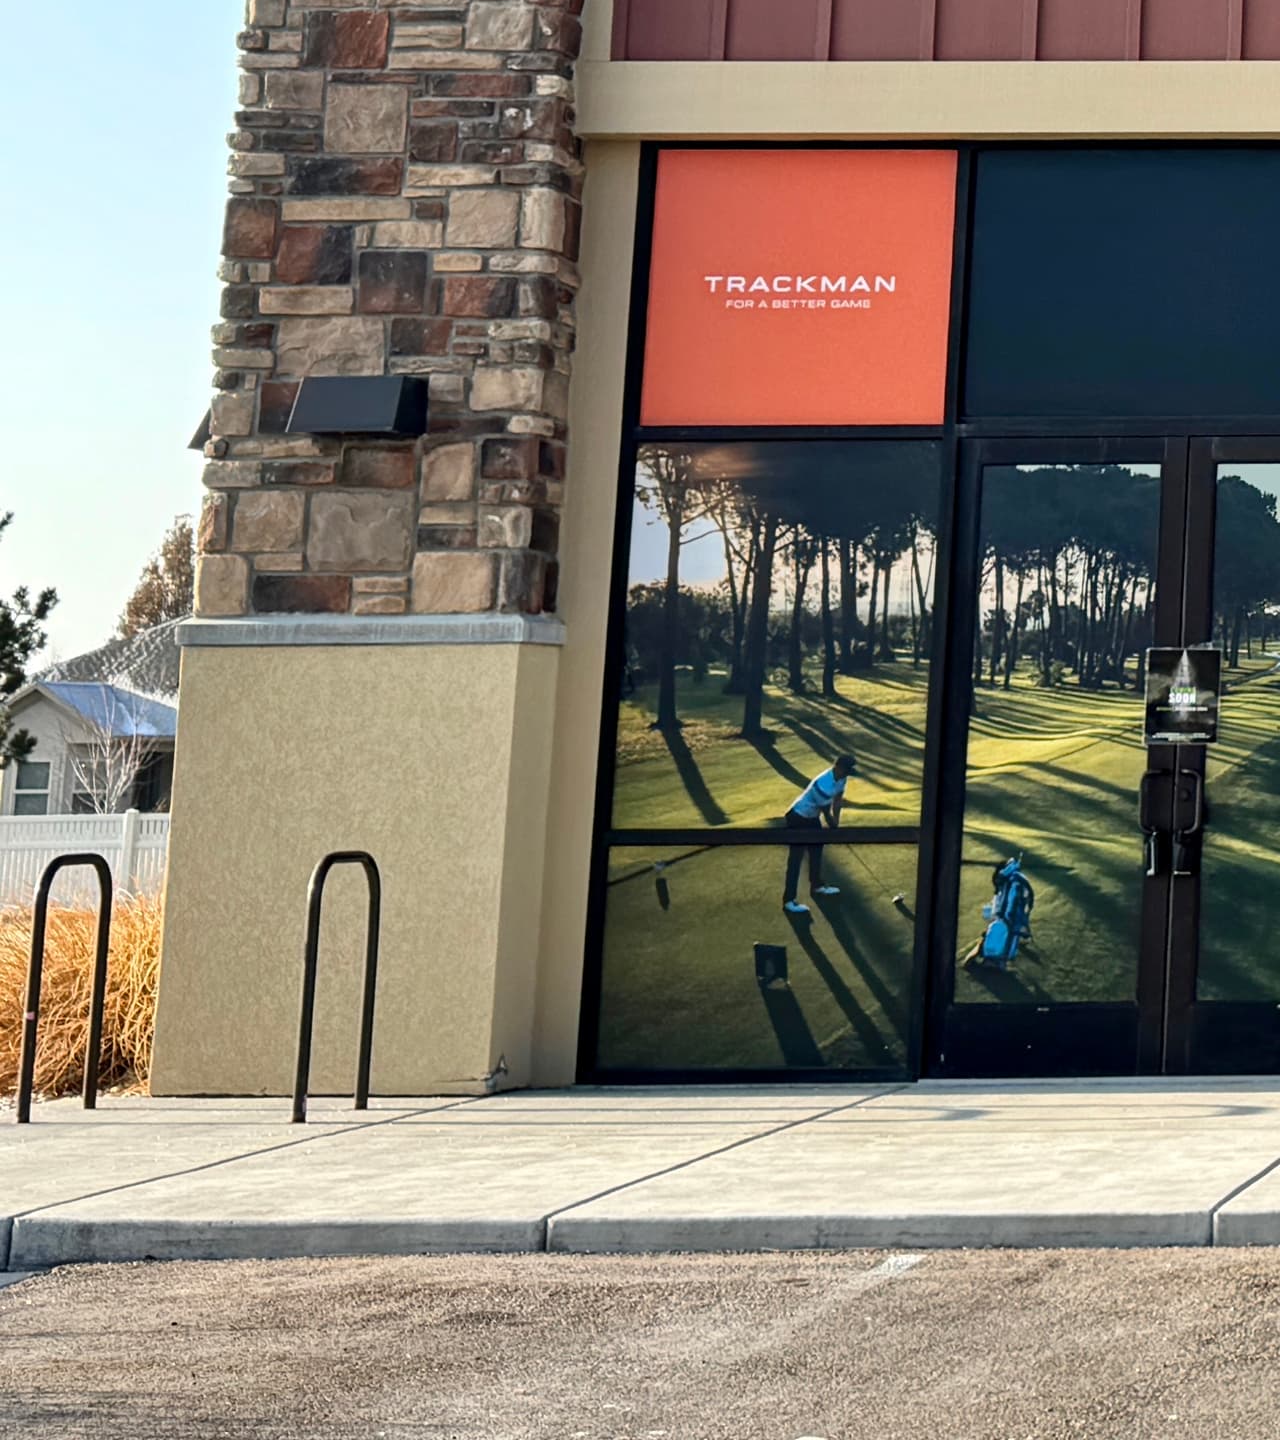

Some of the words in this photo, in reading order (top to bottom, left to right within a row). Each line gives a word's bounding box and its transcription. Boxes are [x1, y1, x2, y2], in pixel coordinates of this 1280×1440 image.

[704, 275, 896, 293] TRACKMAN
[725, 299, 754, 309] FOR
[758, 300, 768, 308] A
[772, 299, 826, 309] BETTER
[830, 299, 871, 309] GAME
